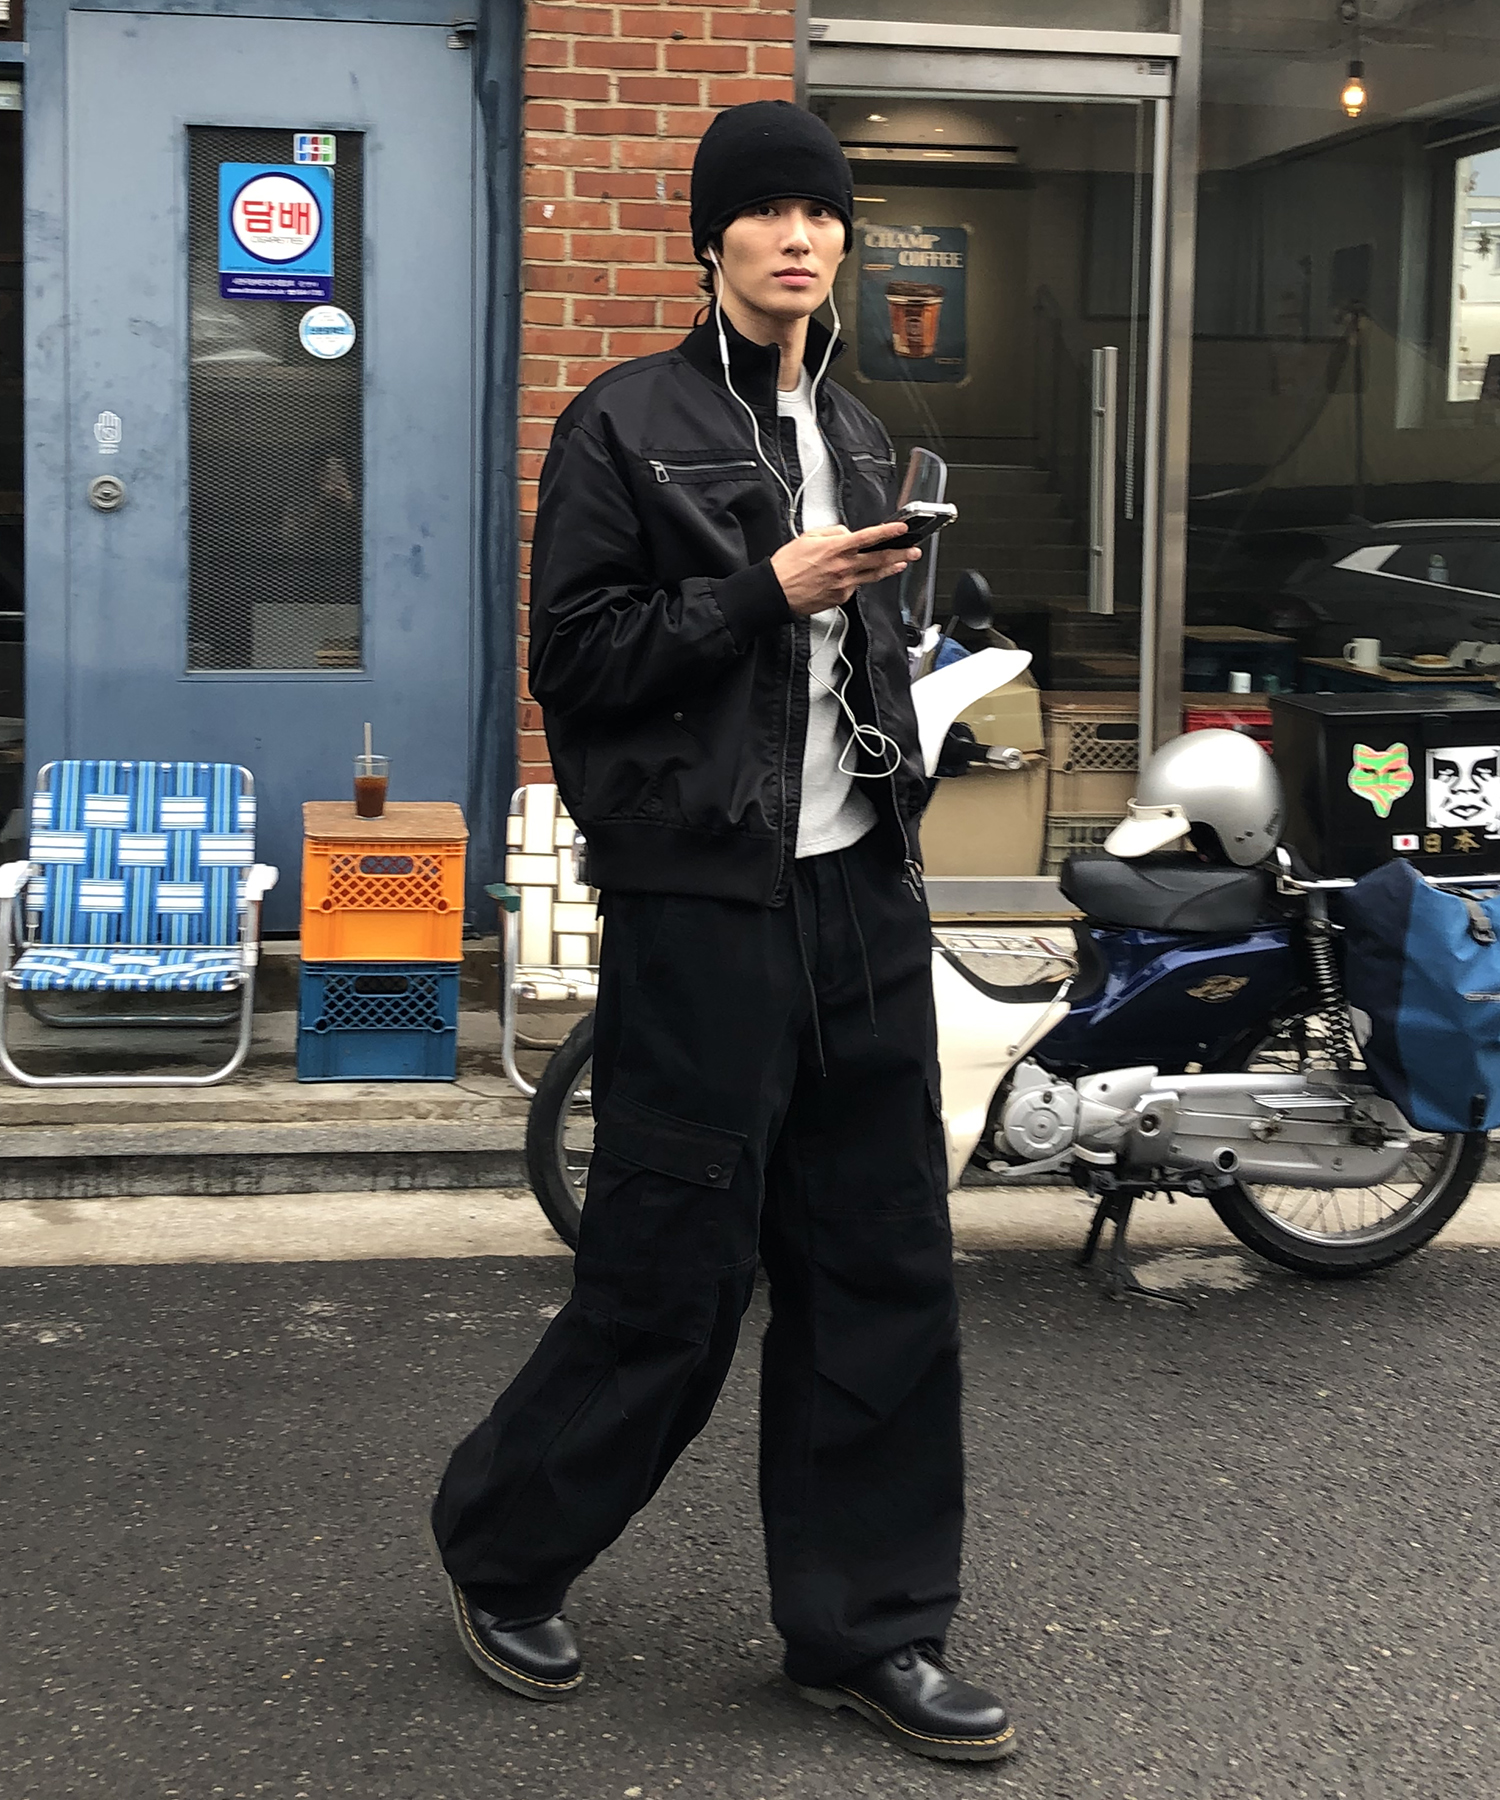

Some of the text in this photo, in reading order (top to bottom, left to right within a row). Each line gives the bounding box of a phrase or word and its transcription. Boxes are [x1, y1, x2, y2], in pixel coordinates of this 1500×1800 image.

[242, 200, 311, 235] 담배
[864, 232, 941, 249] CHAMP
[898, 251, 964, 268] COFFEE
